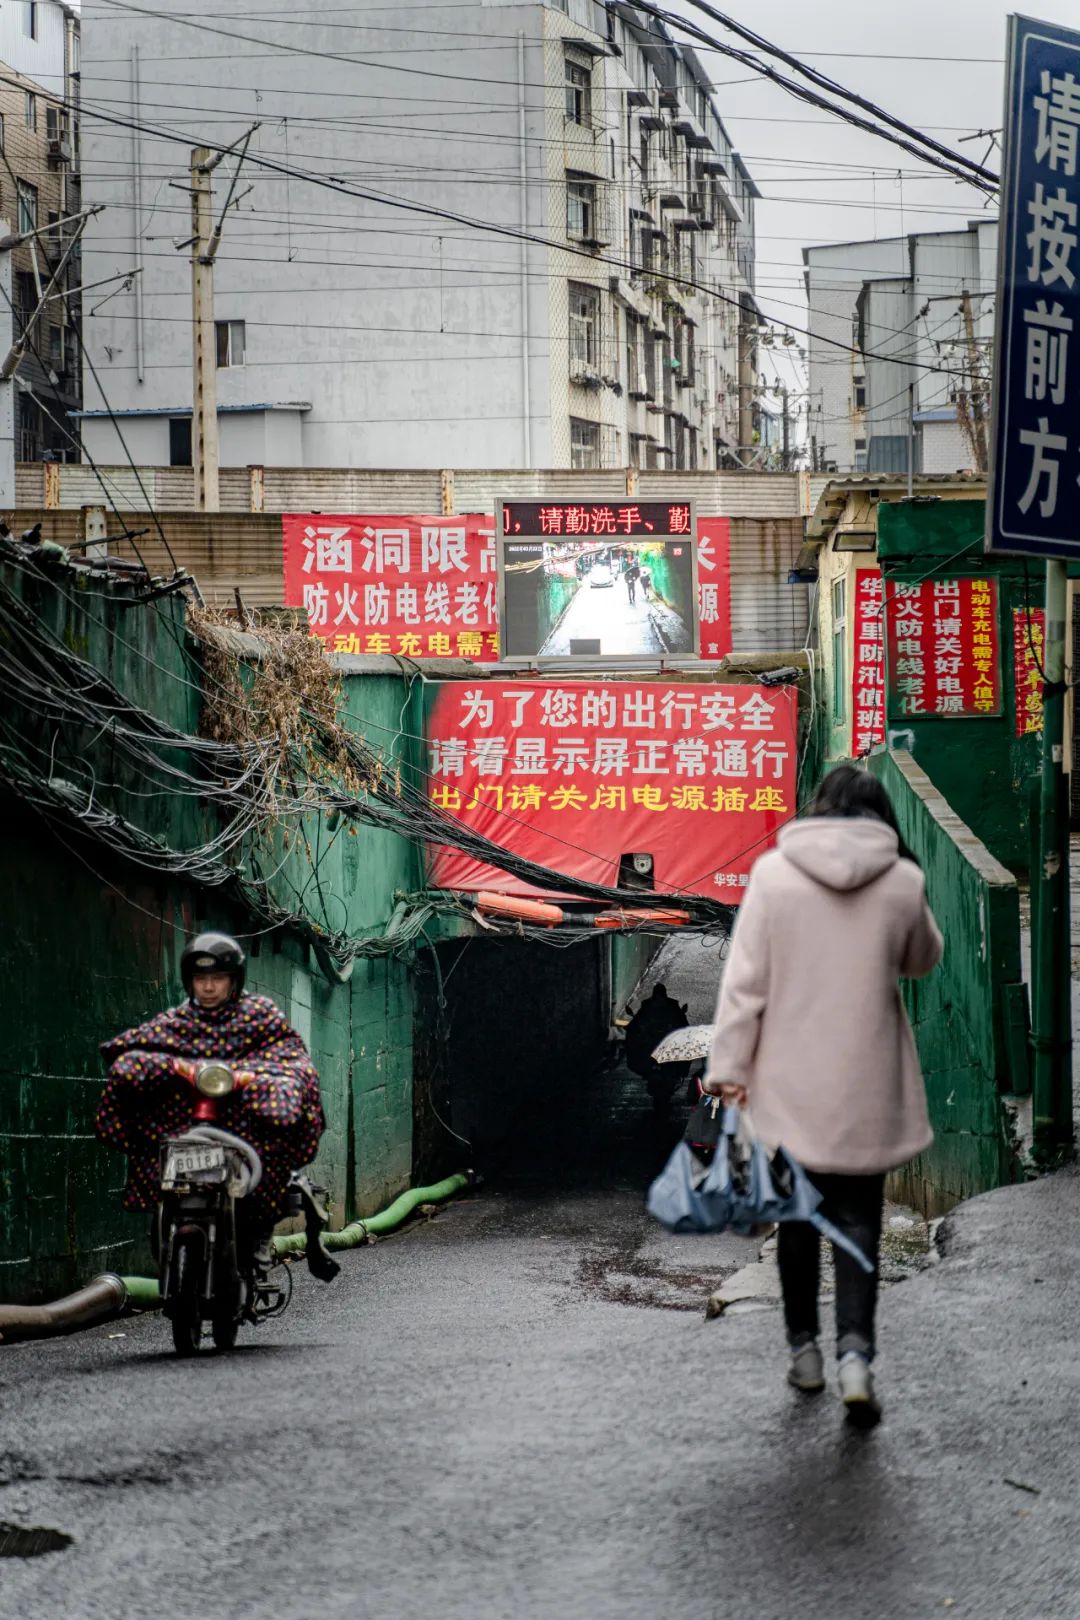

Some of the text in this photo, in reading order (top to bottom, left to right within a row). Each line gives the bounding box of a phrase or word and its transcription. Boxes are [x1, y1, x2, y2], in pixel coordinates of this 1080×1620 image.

[1016, 70, 1080, 518] 请按前方
[458, 688, 775, 731] 为了您的出行安全
[894, 580, 926, 714] 防火防电线老化
[932, 580, 964, 713] 出门请关好电源
[971, 579, 994, 712] 电动车充电需专人值守
[429, 737, 789, 778] 请看显示屏正常通行
[431, 783, 788, 813] 出门请关闭电源插座
